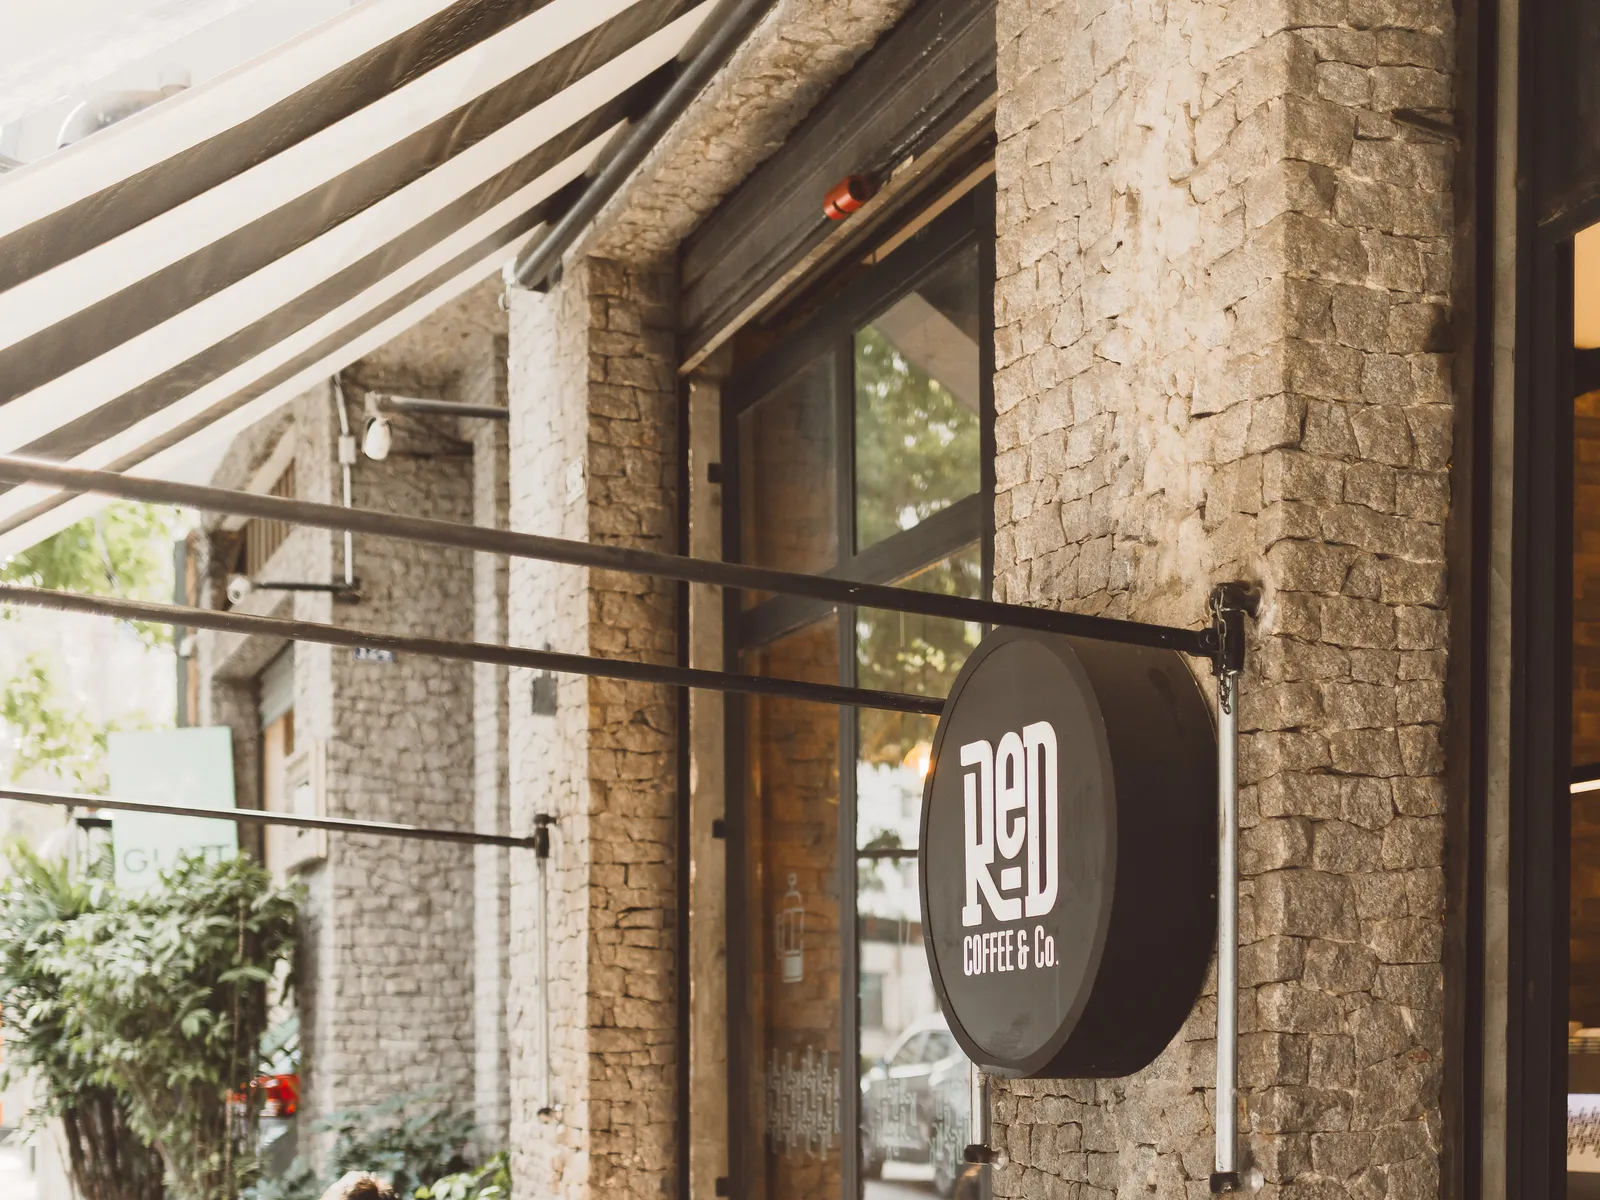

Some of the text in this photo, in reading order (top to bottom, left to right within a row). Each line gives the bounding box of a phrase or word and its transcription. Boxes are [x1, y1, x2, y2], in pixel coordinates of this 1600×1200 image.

[963, 924, 1059, 976] COFFEE & Co.
